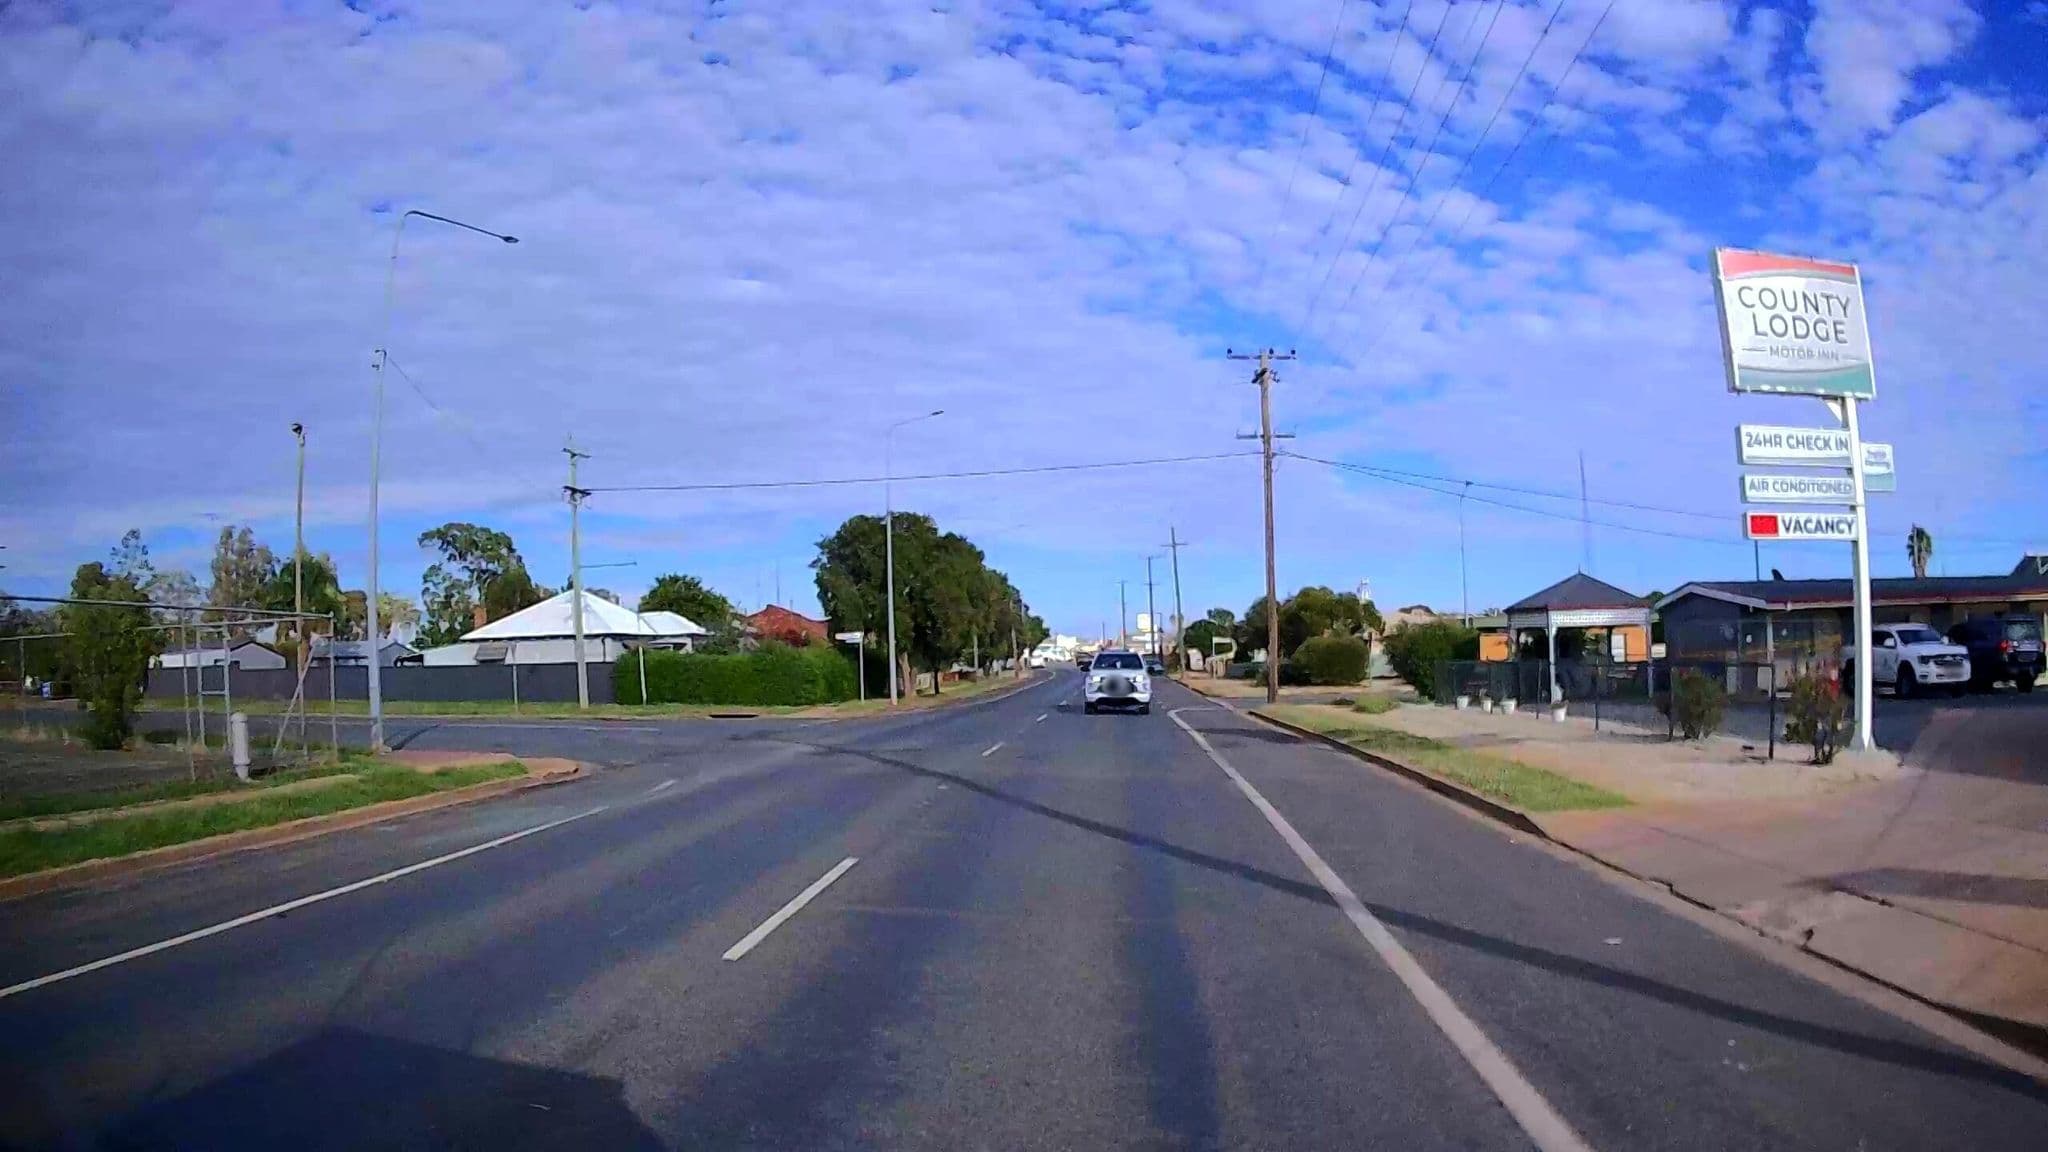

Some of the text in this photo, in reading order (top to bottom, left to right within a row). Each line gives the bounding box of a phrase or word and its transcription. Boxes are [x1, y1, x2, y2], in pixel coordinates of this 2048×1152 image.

[1737, 286, 1851, 318] COUNTY
[1752, 311, 1848, 344] LODGE
[1769, 345, 1840, 361] MOTOR INN
[1745, 431, 1849, 452] 24HR CHECK IN
[1749, 478, 1853, 495] AIR CONDITIONED
[1781, 516, 1855, 534] VACANCY
